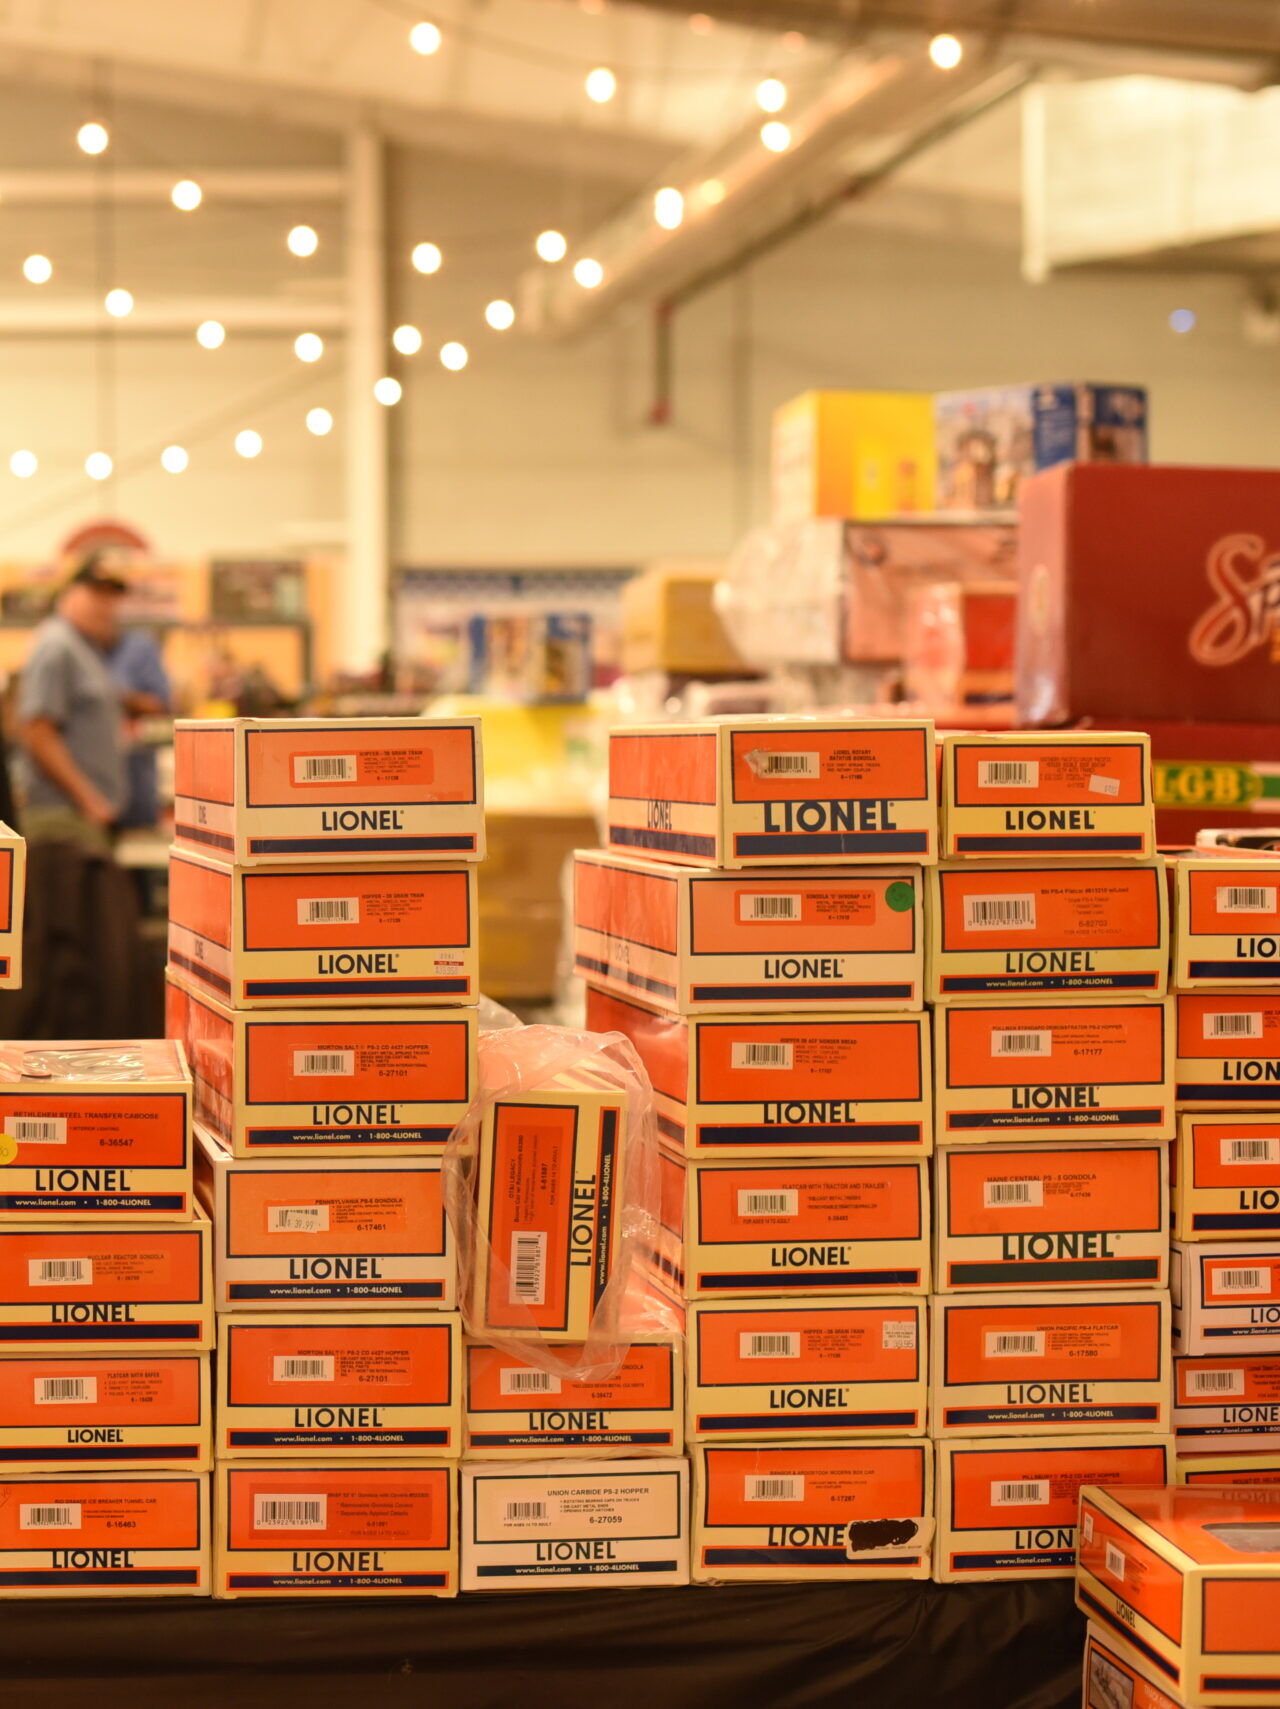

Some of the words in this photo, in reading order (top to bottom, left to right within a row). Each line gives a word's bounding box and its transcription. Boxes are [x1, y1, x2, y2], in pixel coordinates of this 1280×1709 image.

[322, 811, 402, 831] LIONEL
[764, 801, 896, 832] LIONEL
[1006, 810, 1094, 830] LIONEL
[319, 954, 398, 975] LIONEL
[765, 959, 843, 979] LIONEL
[1006, 951, 1095, 973] LIONEL
[986, 980, 1043, 988] www.lionel.com
[1012, 1087, 1099, 1109] LIONEL
[313, 1105, 401, 1125] LIONEL
[763, 1103, 855, 1124] LIONEL
[992, 1117, 1049, 1125] www.lionel.com
[293, 1132, 350, 1141] www.lionel.com
[369, 1132, 422, 1140] 1-800-4LIONEL
[36, 1170, 130, 1191] LIONEL
[570, 1174, 596, 1267] LIONEL
[1003, 1233, 1113, 1260] LIONEL
[772, 1248, 849, 1267] LIONEL
[290, 1258, 381, 1279] LIONEL
[52, 1305, 134, 1322] LIONEL
[770, 1389, 847, 1408] LIONEL
[1007, 1385, 1093, 1404] LIONEL
[294, 1408, 383, 1428] LIONEL
[529, 1411, 608, 1430] LIONEL
[1063, 1410, 1113, 1418] 1-800-4LIONEL
[67, 1430, 123, 1443] LIONEL
[589, 1516, 622, 1524] 6-27059
[53, 1551, 133, 1569] LIONEL
[536, 1541, 615, 1561] LIONEL
[293, 1552, 383, 1572] LIONEL
[1116, 1600, 1136, 1628] LIONEL
